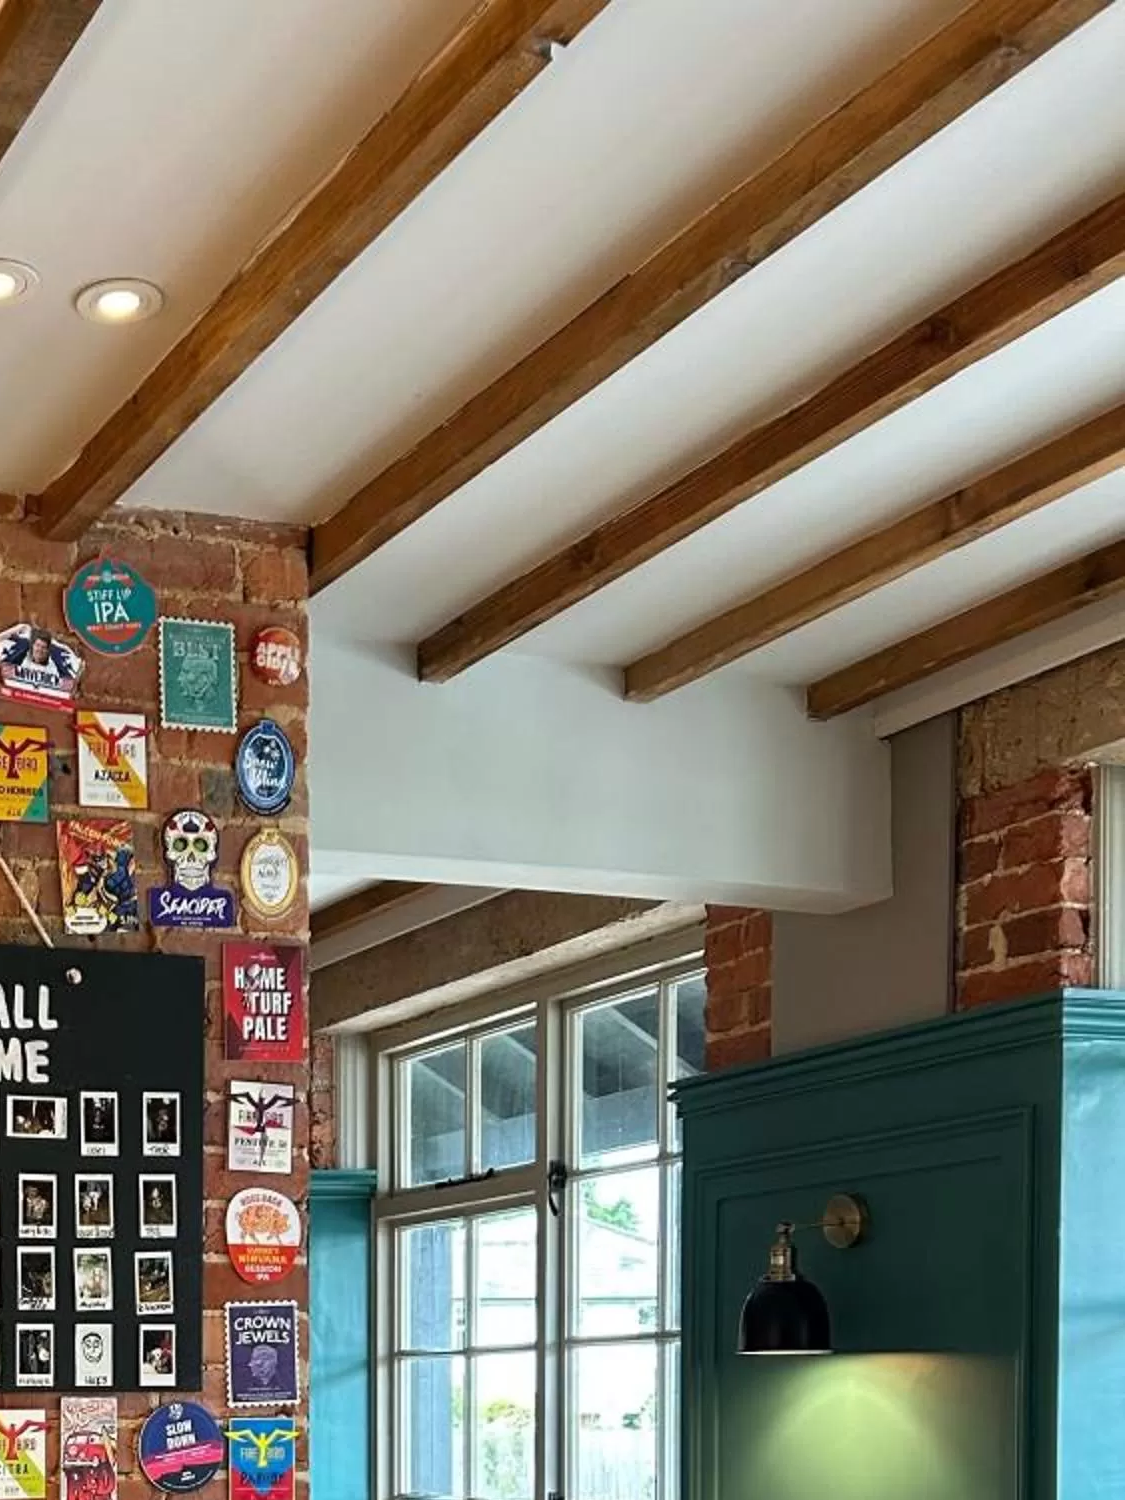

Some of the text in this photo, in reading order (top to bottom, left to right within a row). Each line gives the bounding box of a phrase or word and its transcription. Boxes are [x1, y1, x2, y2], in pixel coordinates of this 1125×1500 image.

[87, 589, 113, 602] STIFF
[94, 602, 129, 623] IPA
[158, 890, 227, 918] SEACIDER
[248, 991, 292, 1014] TURF
[242, 1016, 287, 1041] PALE
[234, 1315, 292, 1331] CROWN
[236, 1330, 290, 1345] JEWELS
[165, 1419, 192, 1437] SLOW
[166, 1433, 196, 1449] DOWN
